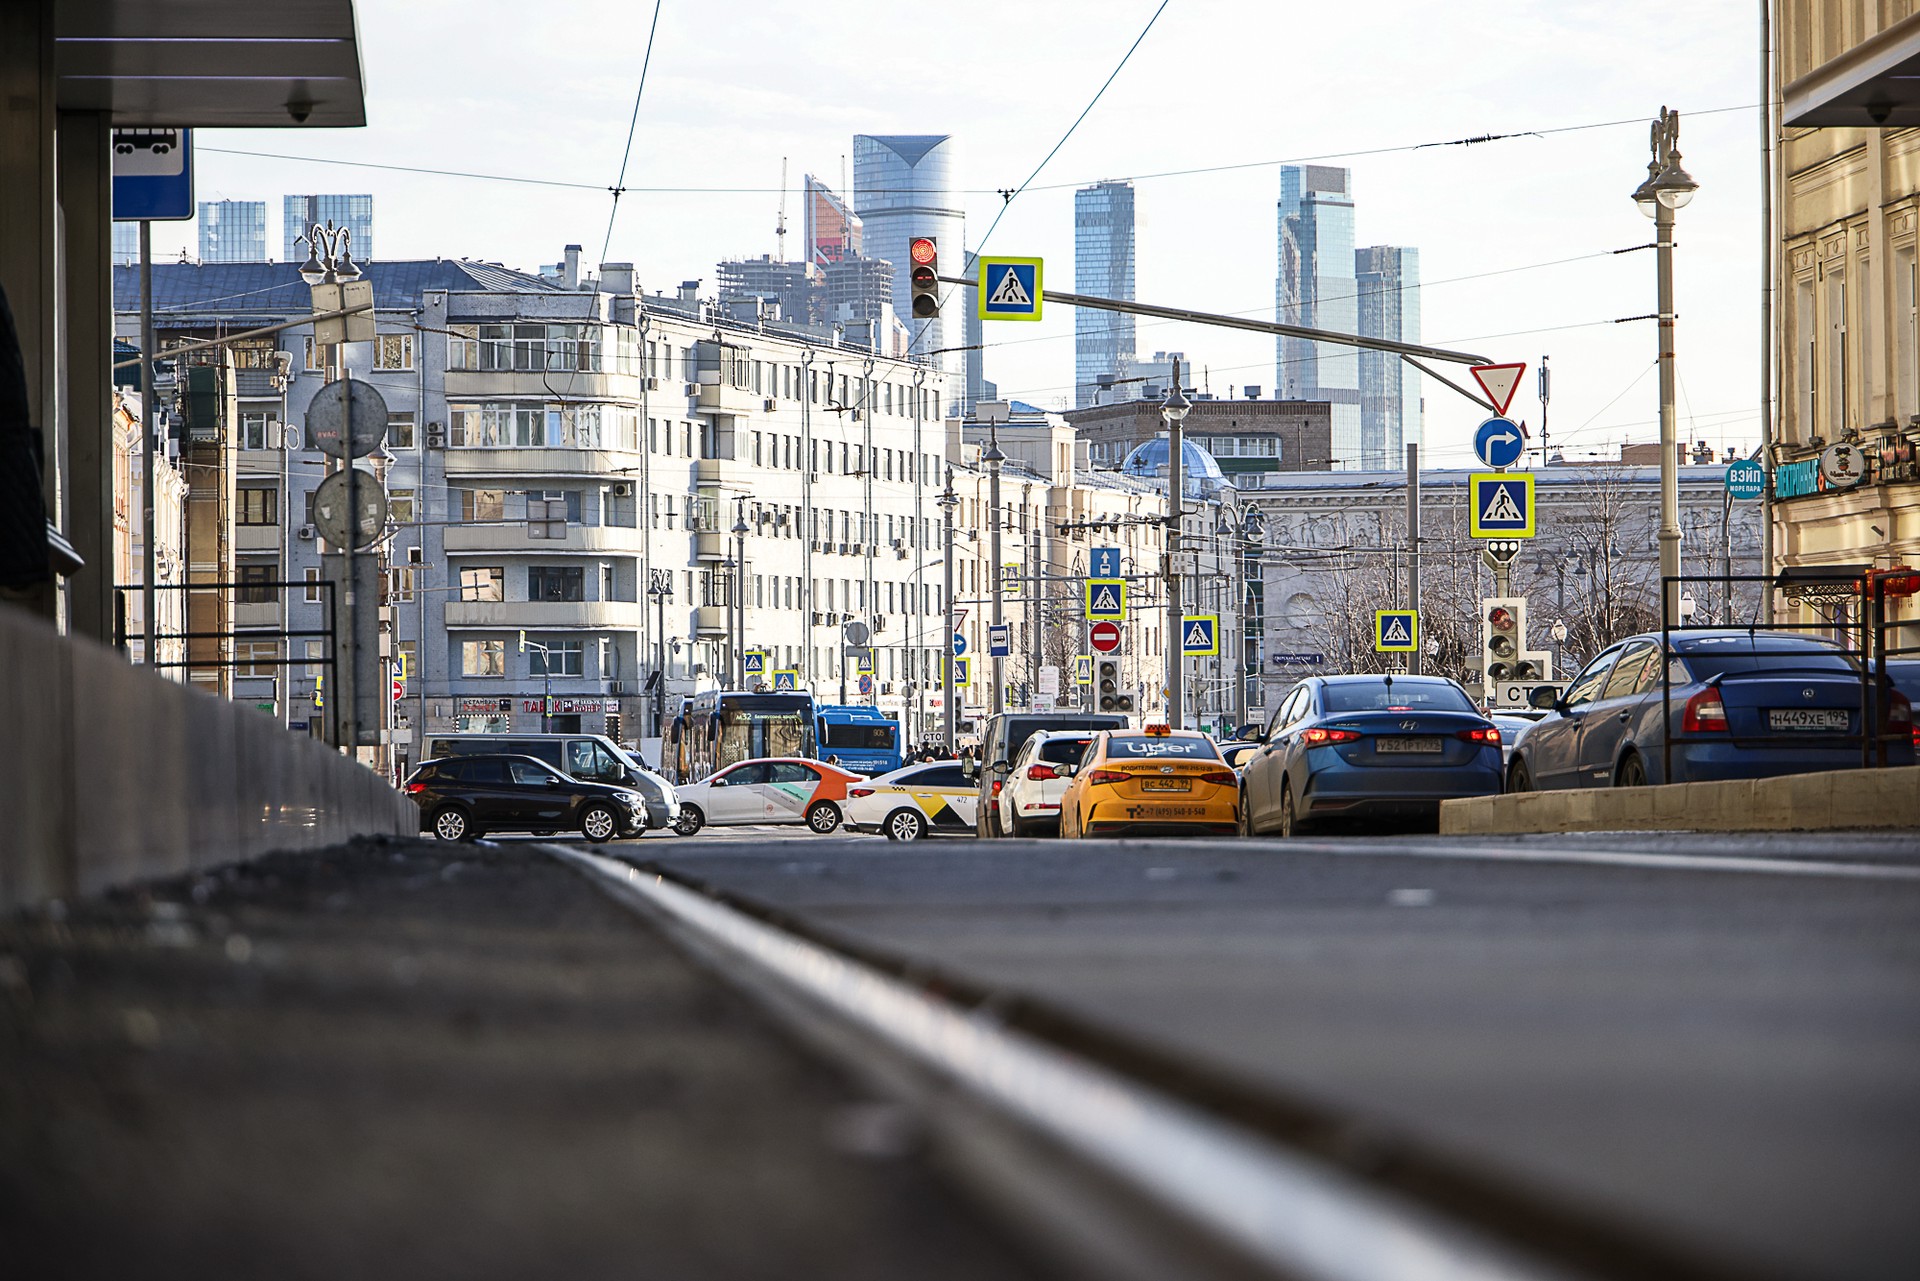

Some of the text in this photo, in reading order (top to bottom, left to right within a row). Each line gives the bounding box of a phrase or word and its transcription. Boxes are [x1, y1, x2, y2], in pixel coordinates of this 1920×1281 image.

[1730, 467, 1761, 483] ВЭЙП
[1315, 655, 1320, 663] 1
[1507, 686, 1563, 702] СТП
[522, 700, 560, 713] ТАБК
[1774, 711, 1825, 725] Н449ХЕ
[1158, 779, 1175, 788] 442
